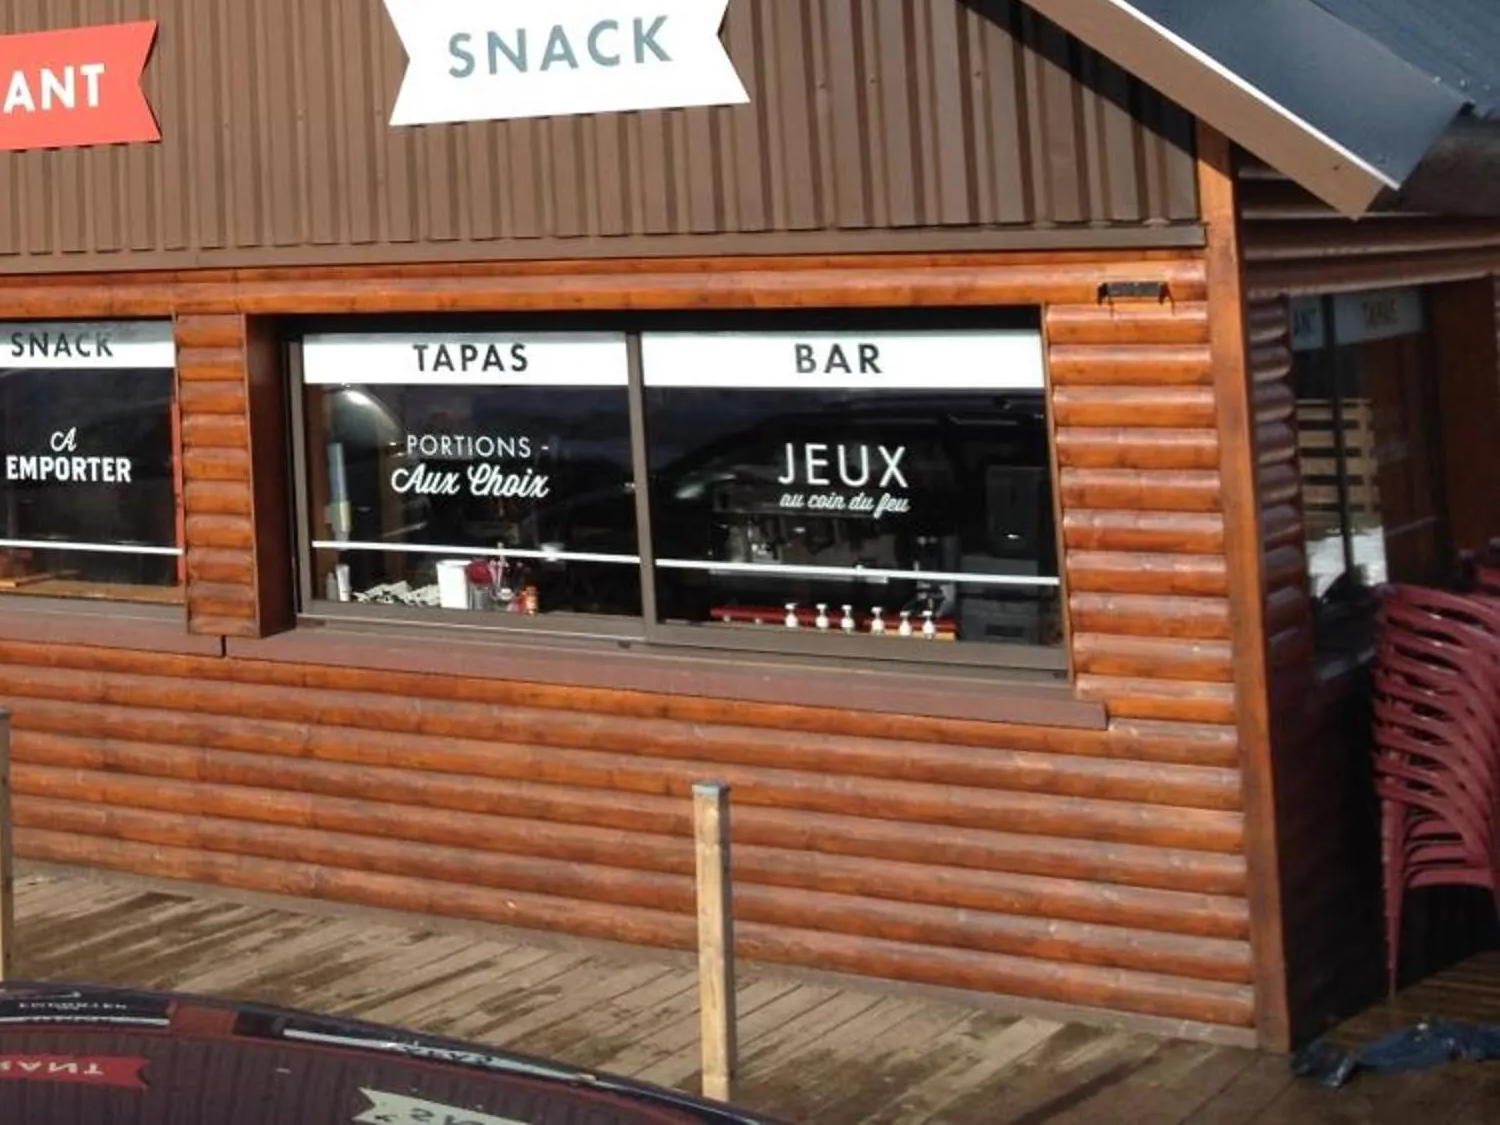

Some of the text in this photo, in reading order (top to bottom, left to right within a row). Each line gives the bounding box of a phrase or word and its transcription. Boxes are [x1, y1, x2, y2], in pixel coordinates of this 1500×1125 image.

[448, 15, 673, 78] SNACK
[11, 332, 114, 357] SNACK
[412, 343, 528, 372] TAPAS
[794, 343, 883, 373] BAR
[407, 434, 531, 457] PORTIONS
[6, 455, 131, 483] EMPORTER
[778, 442, 908, 488] JEUX
[391, 463, 550, 498] Aux Choix
[780, 491, 911, 519] au coin du feu
